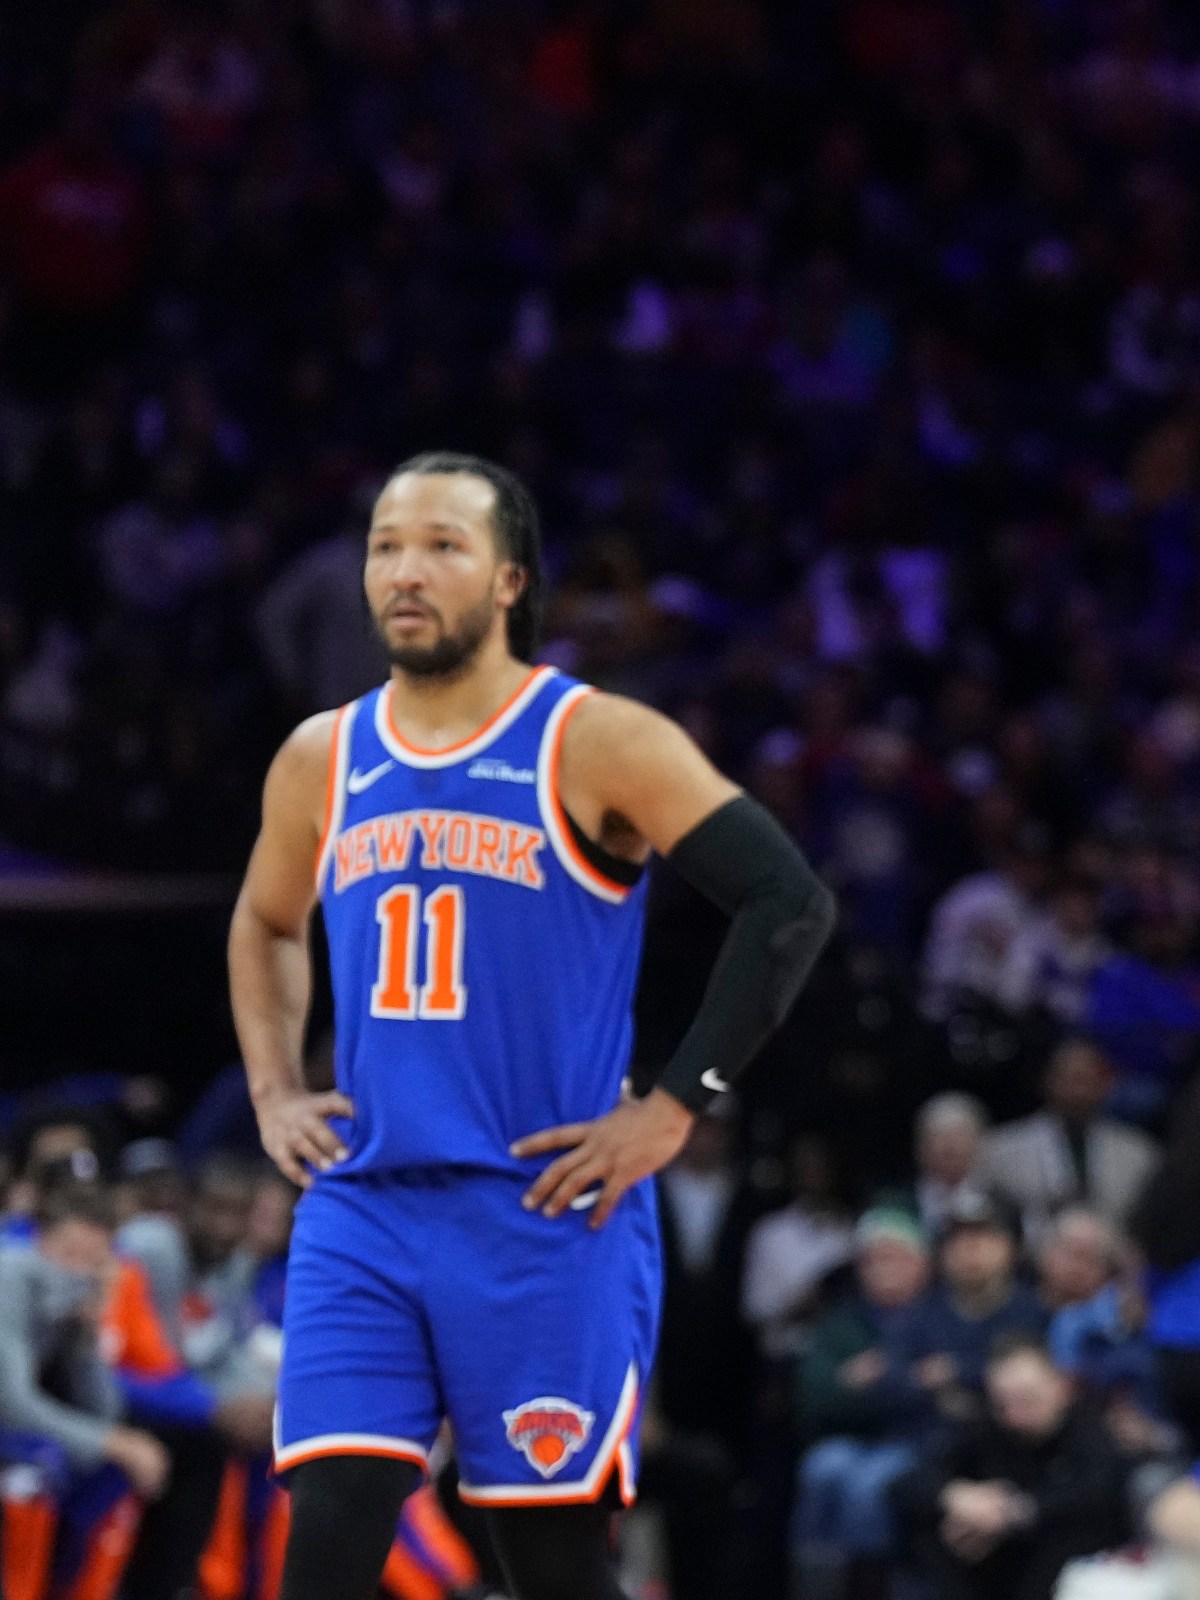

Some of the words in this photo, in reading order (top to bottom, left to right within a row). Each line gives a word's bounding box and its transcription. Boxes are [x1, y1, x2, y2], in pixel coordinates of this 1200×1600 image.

[333, 812, 414, 895] NEW
[416, 809, 547, 892] YORK
[370, 884, 467, 1021] 11
